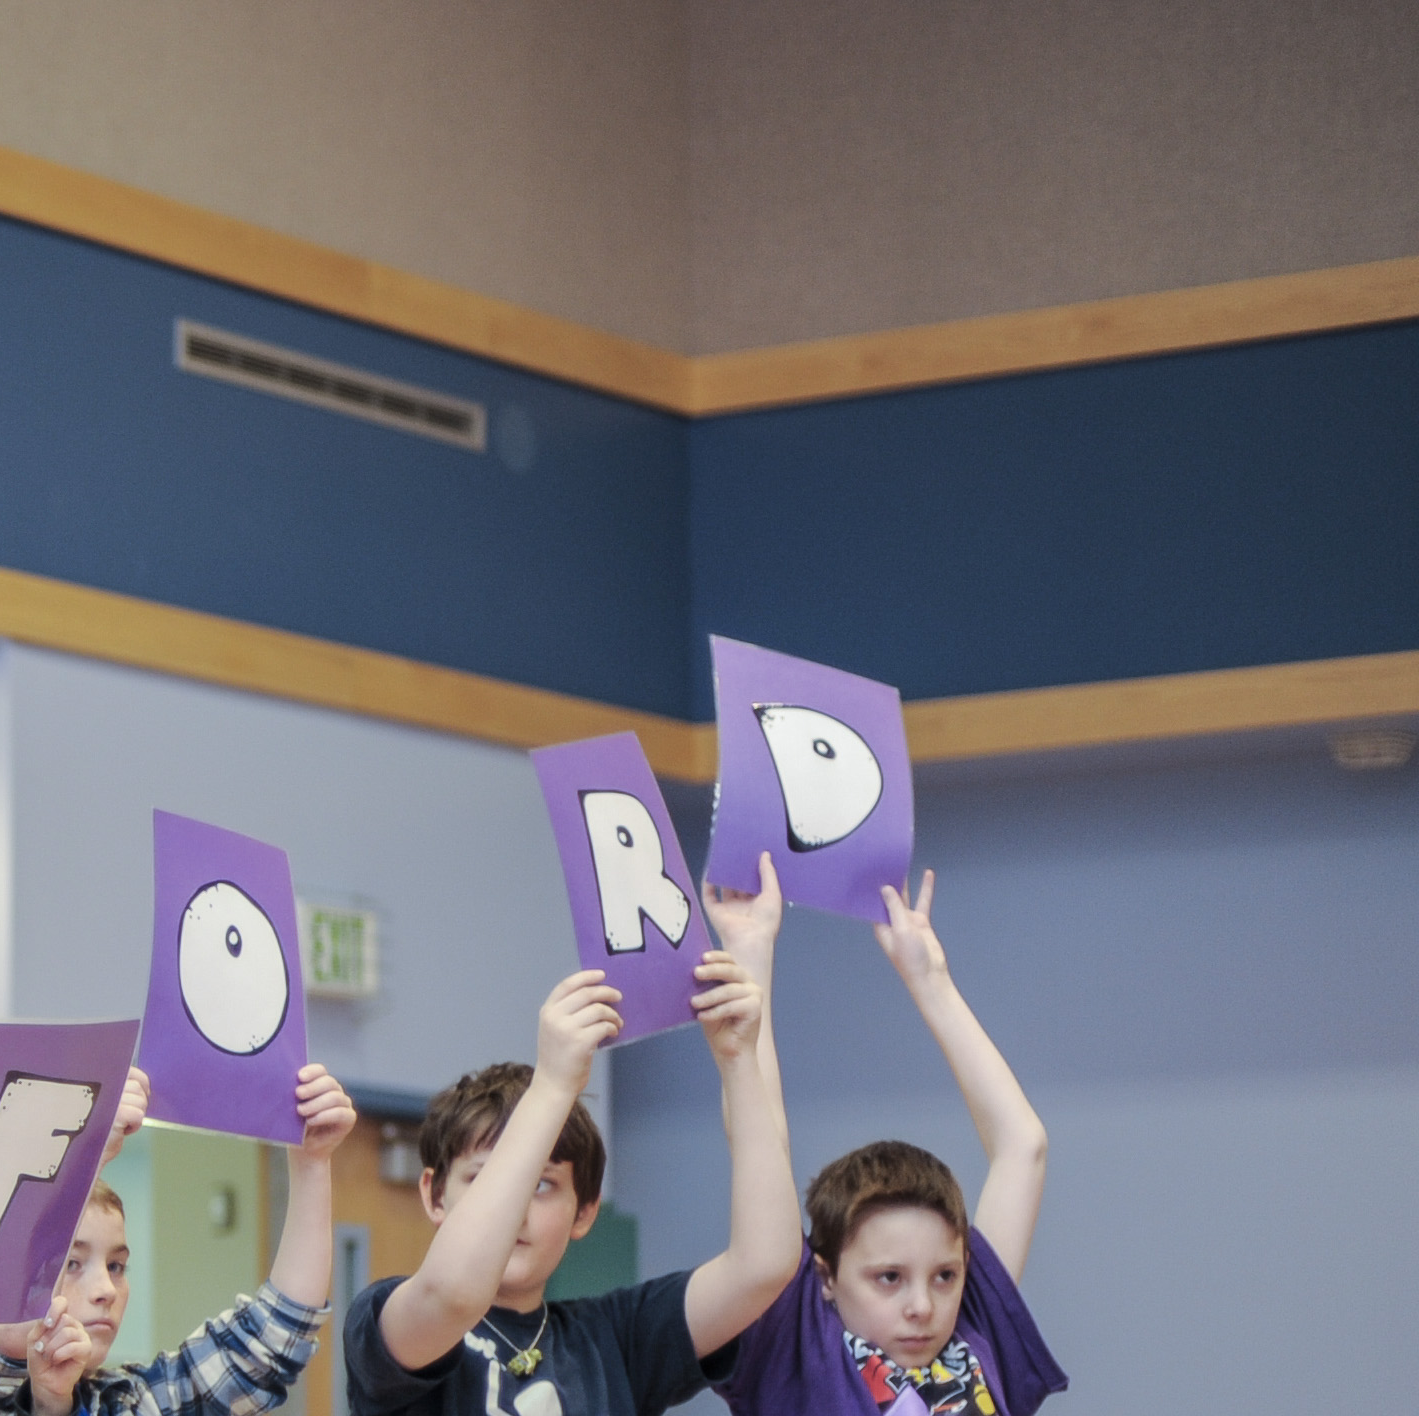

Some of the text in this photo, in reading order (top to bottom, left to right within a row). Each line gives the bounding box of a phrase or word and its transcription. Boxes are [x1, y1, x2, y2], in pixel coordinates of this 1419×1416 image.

[751, 703, 883, 853] D
[577, 789, 691, 955] R
[178, 880, 289, 1056] O
